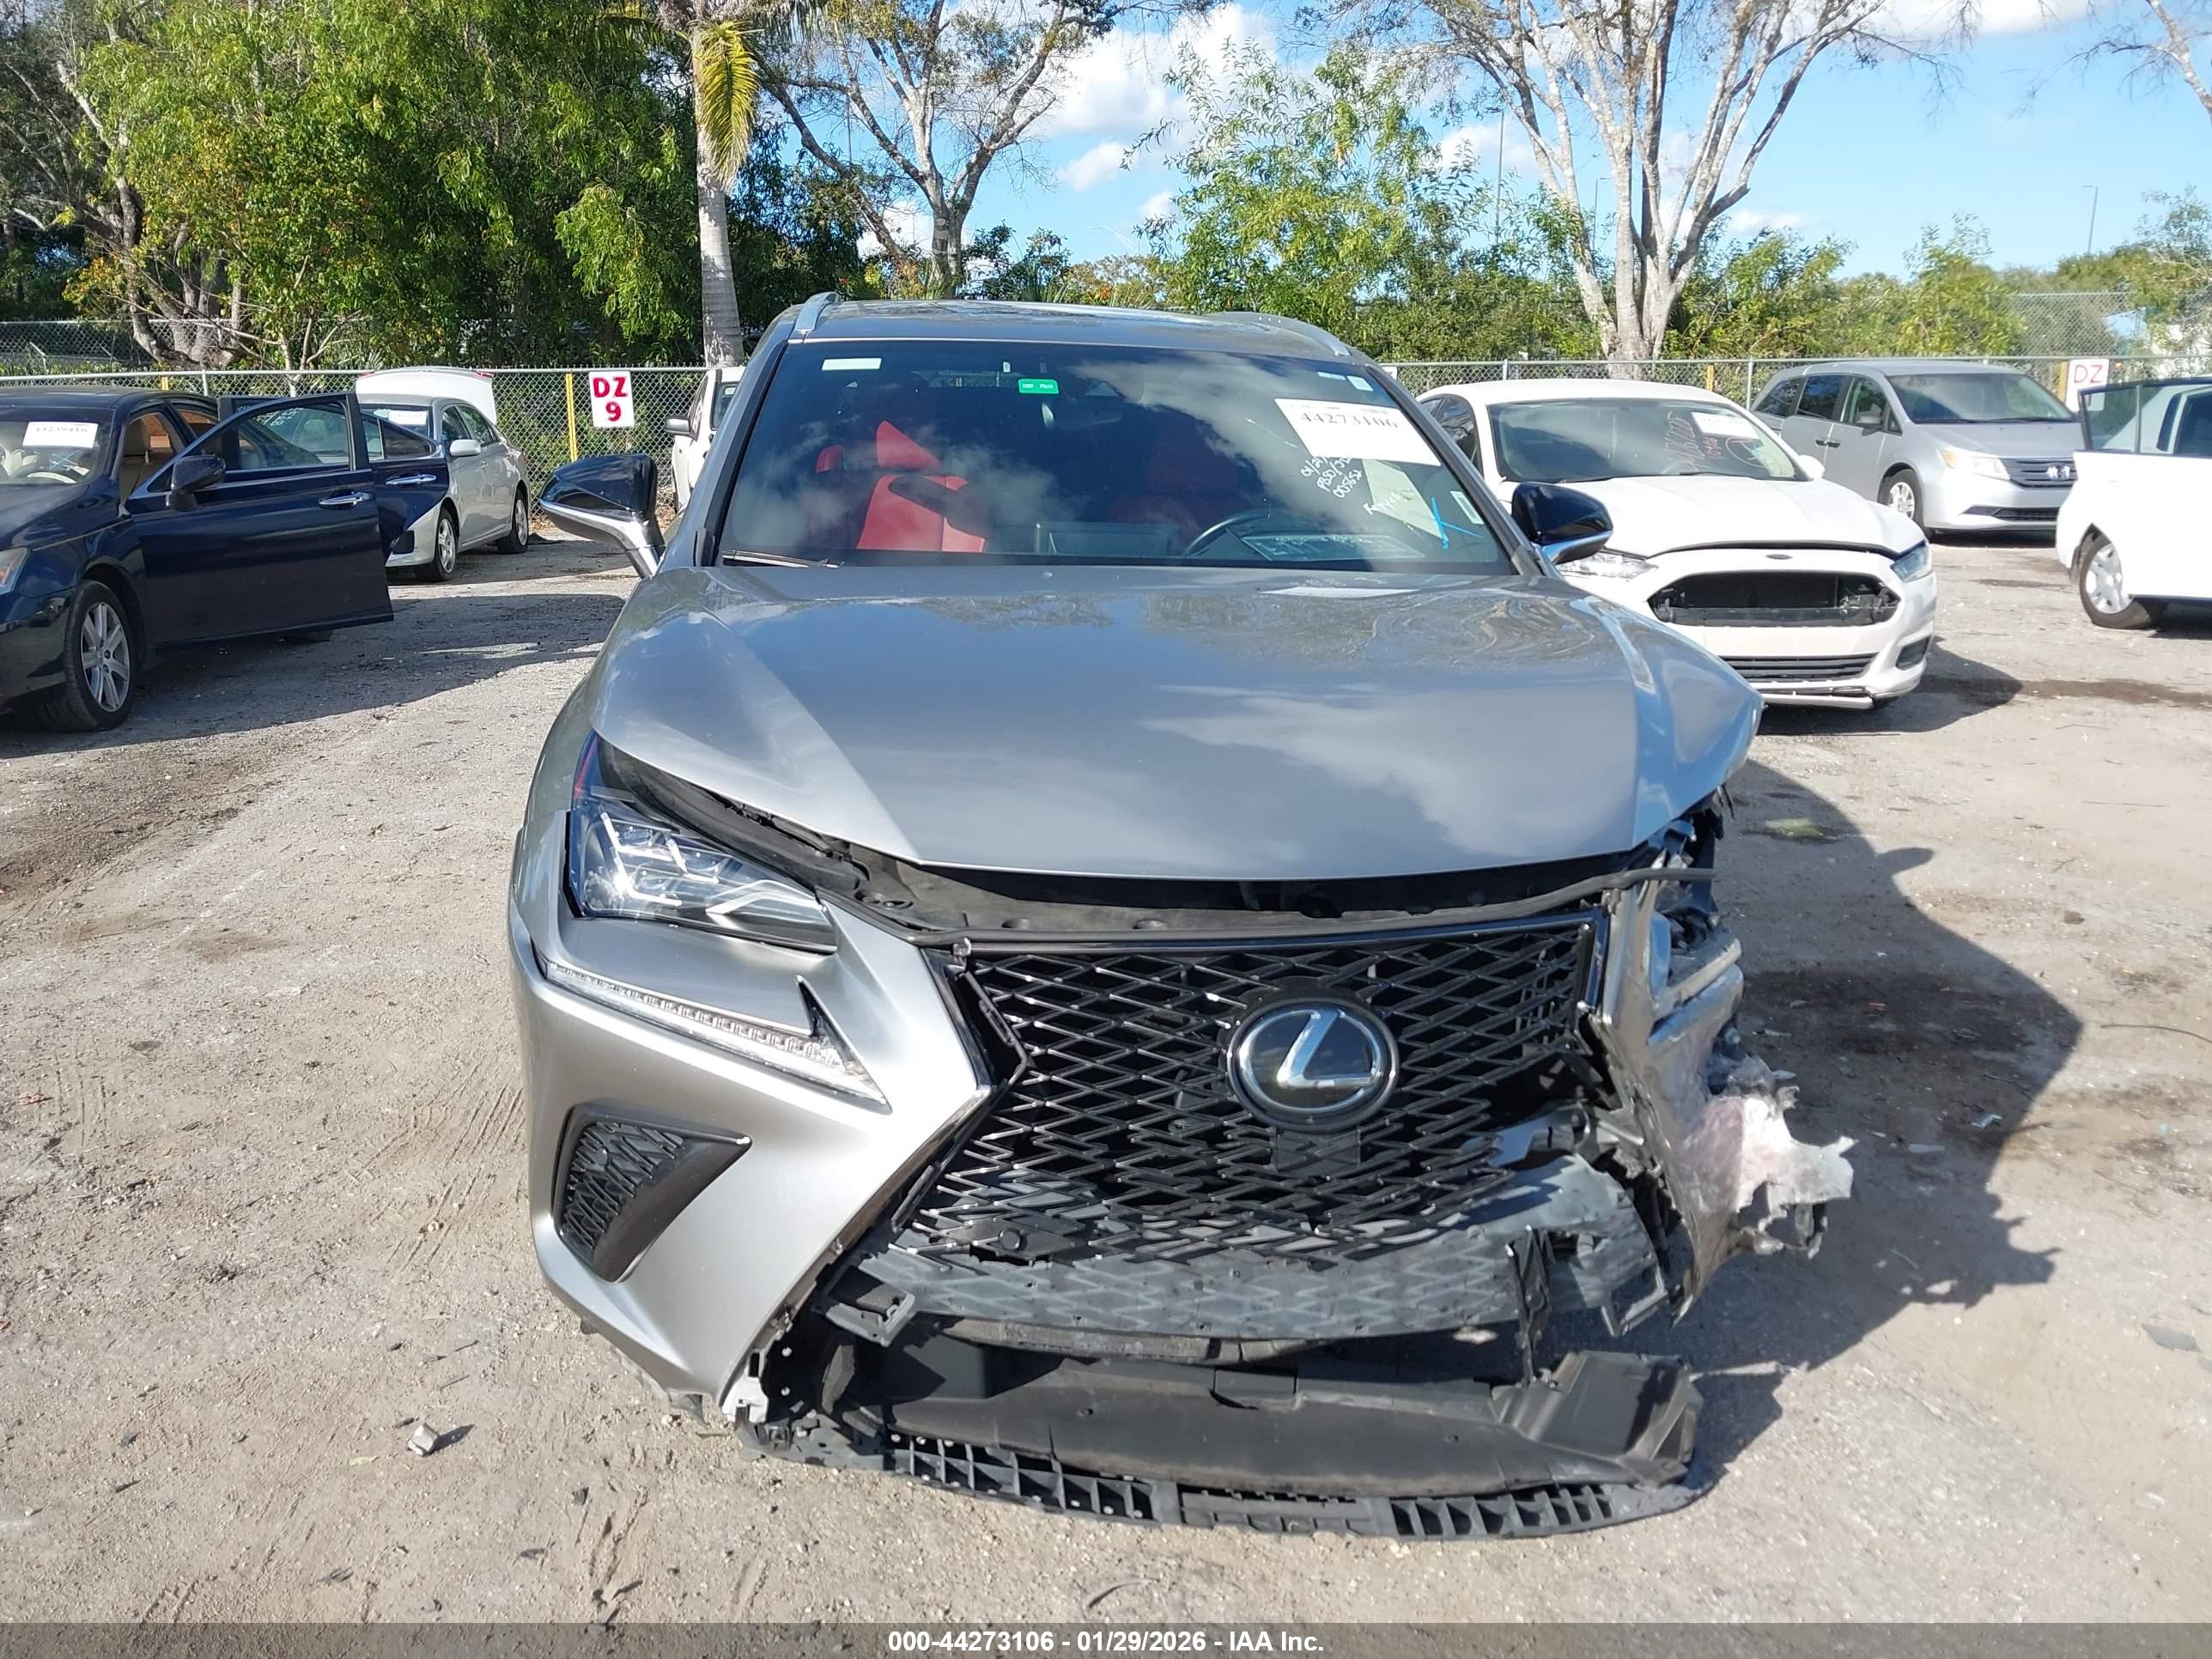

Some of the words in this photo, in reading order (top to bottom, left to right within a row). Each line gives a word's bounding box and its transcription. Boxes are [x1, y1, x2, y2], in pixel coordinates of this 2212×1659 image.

[2074, 364, 2103, 384] DZ
[592, 376, 628, 398] DZ
[605, 401, 622, 422] 9
[1301, 412, 1398, 428] 44273106
